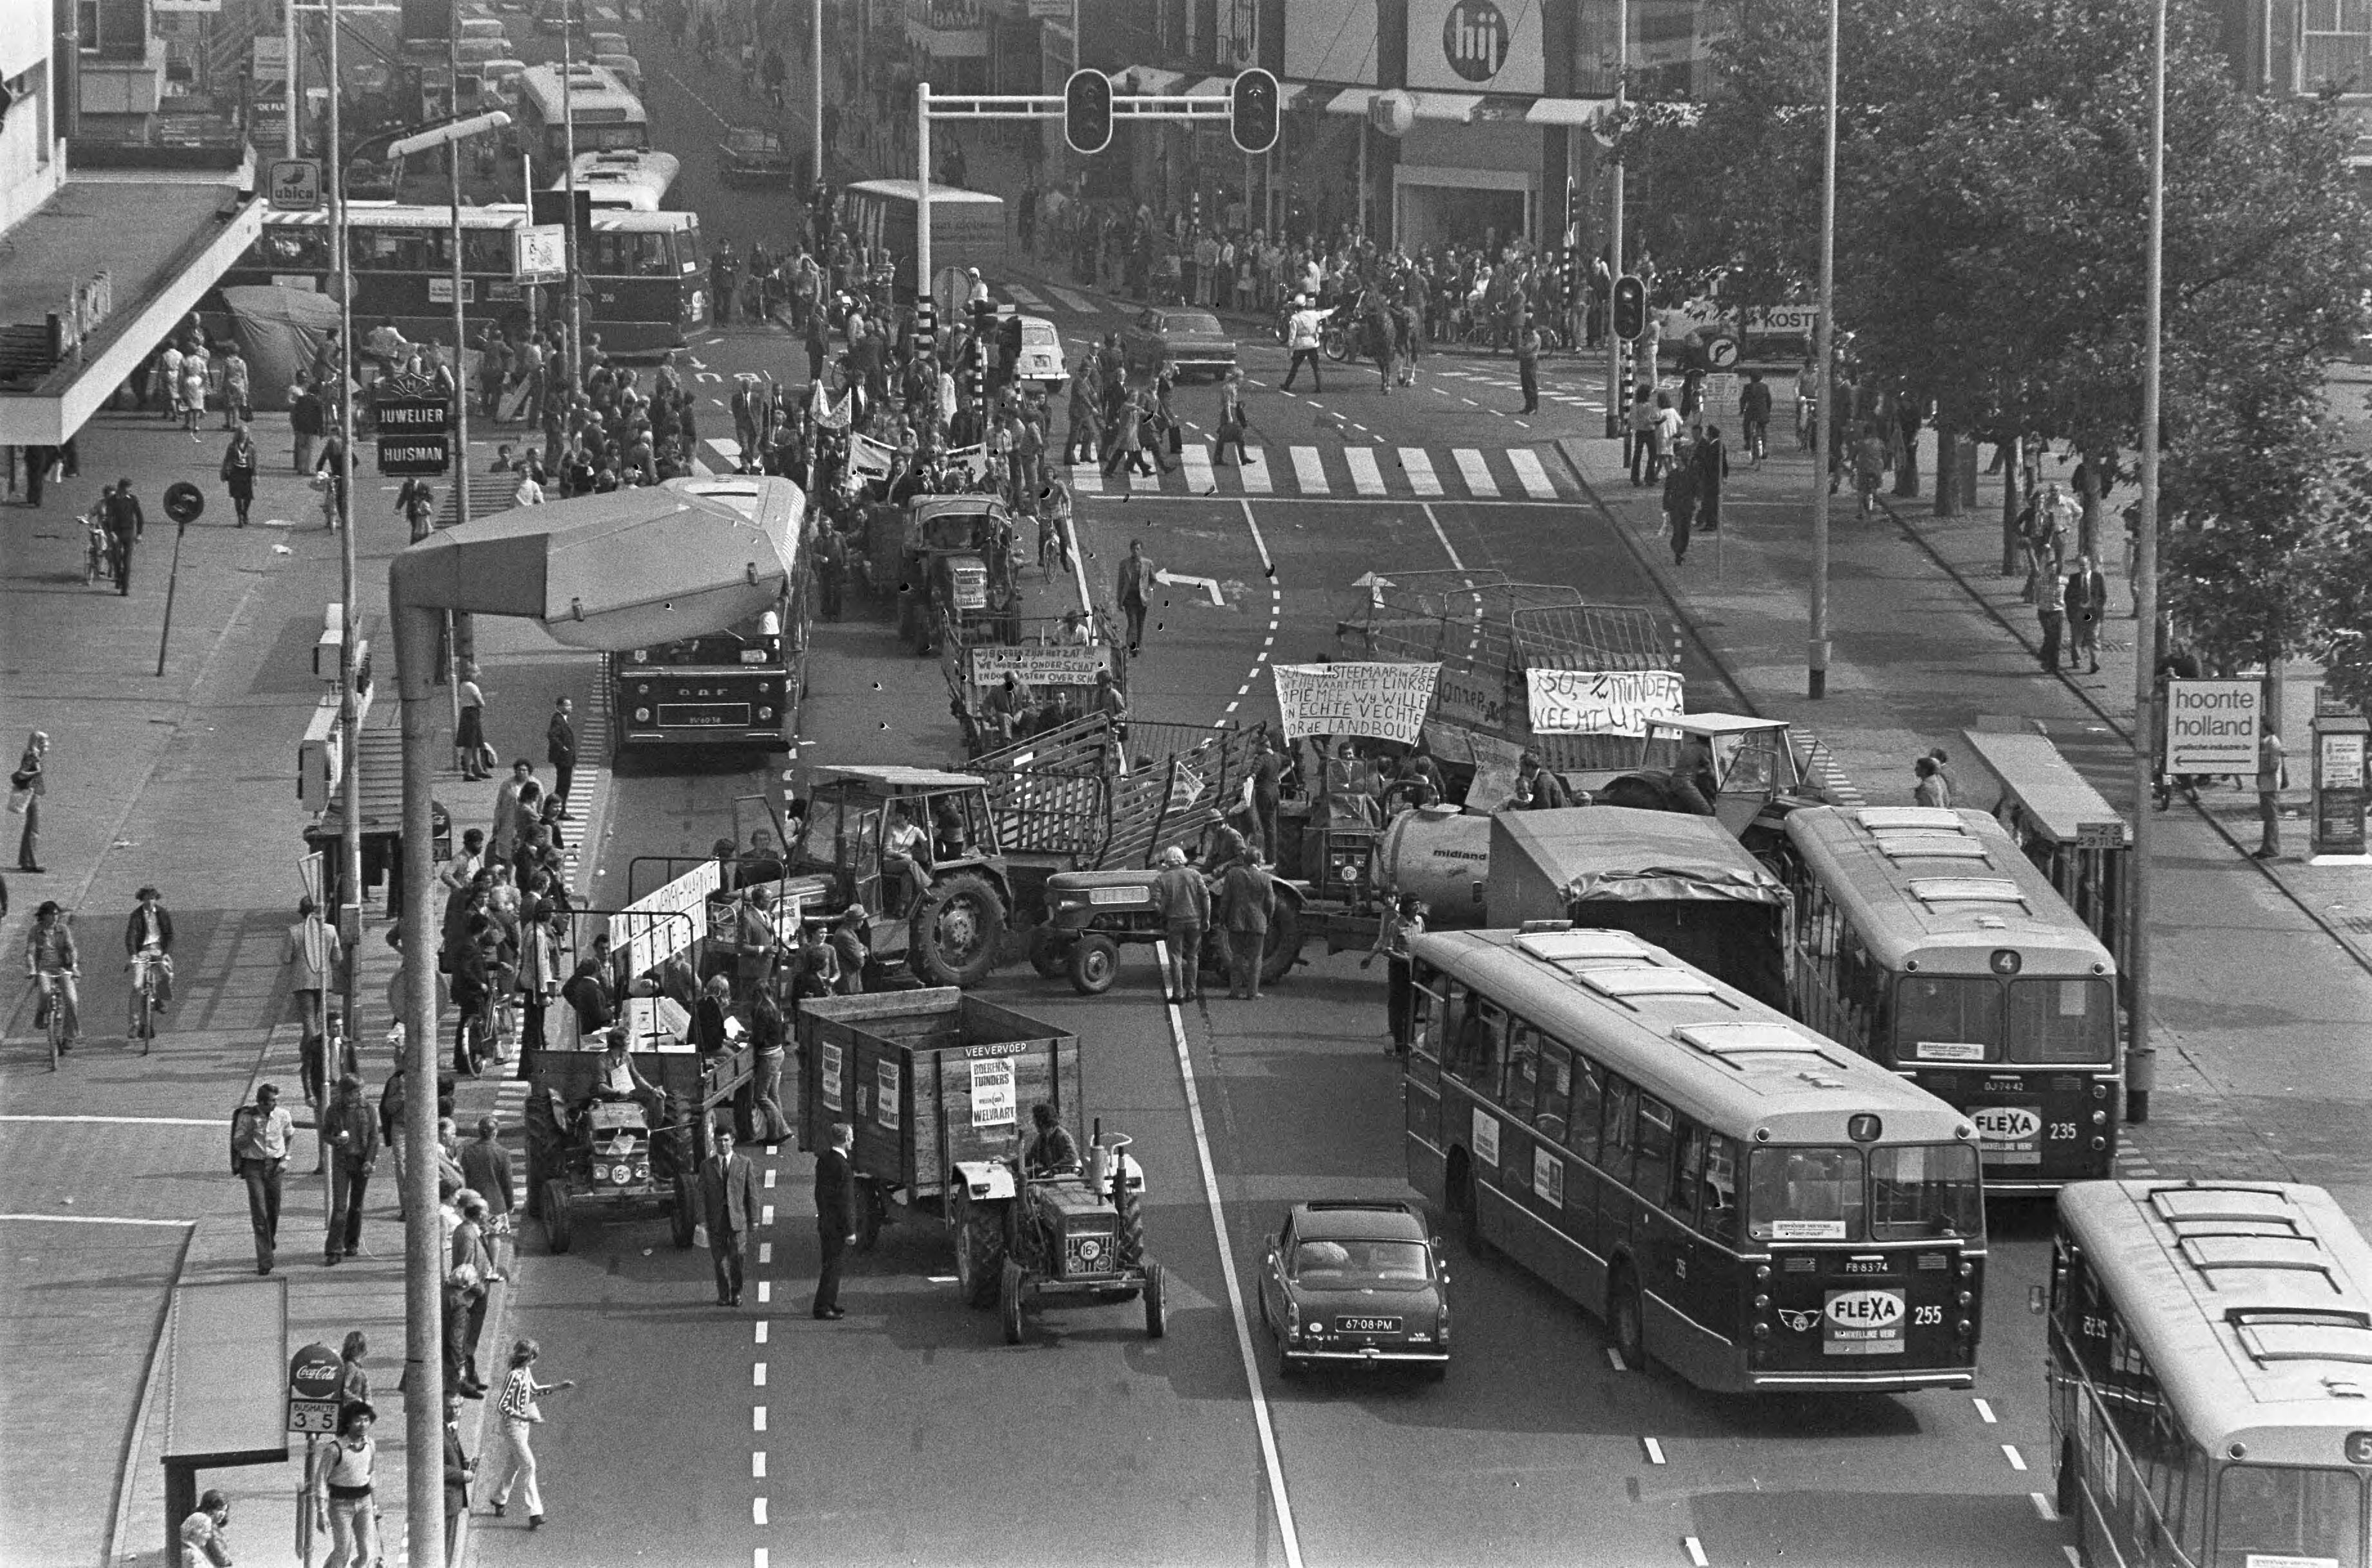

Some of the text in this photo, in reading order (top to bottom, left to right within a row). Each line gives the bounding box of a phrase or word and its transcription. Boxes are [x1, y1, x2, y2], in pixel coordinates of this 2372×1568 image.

[1455, 7, 1497, 74] hij
[275, 186, 314, 199] ubica
[381, 408, 444, 424] JUWELIER
[384, 447, 442, 462] HUISMAN
[2175, 687, 2254, 709] hoonte
[1299, 702, 1352, 716] ECHTE
[1533, 707, 1604, 732] NEEMT
[2174, 715, 2252, 736] holland
[1328, 718, 1420, 743] LANDBOUW
[1433, 849, 1487, 861] midland
[1999, 953, 2013, 969] 4
[965, 1043, 1027, 1058] VEEVERVOER
[974, 1073, 1010, 1088] TUINDERS
[973, 1106, 1015, 1123] WELVAART
[1975, 1112, 2033, 1135] FLEXA
[1857, 1116, 1870, 1135] 7
[2049, 1122, 2078, 1140] 235
[1845, 1262, 1888, 1273] FB-83-74
[1834, 1297, 1897, 1321] FLEXA
[1914, 1305, 1943, 1326] 255
[294, 1412, 333, 1430] 3 5
[2358, 1437, 2372, 1461] 5
